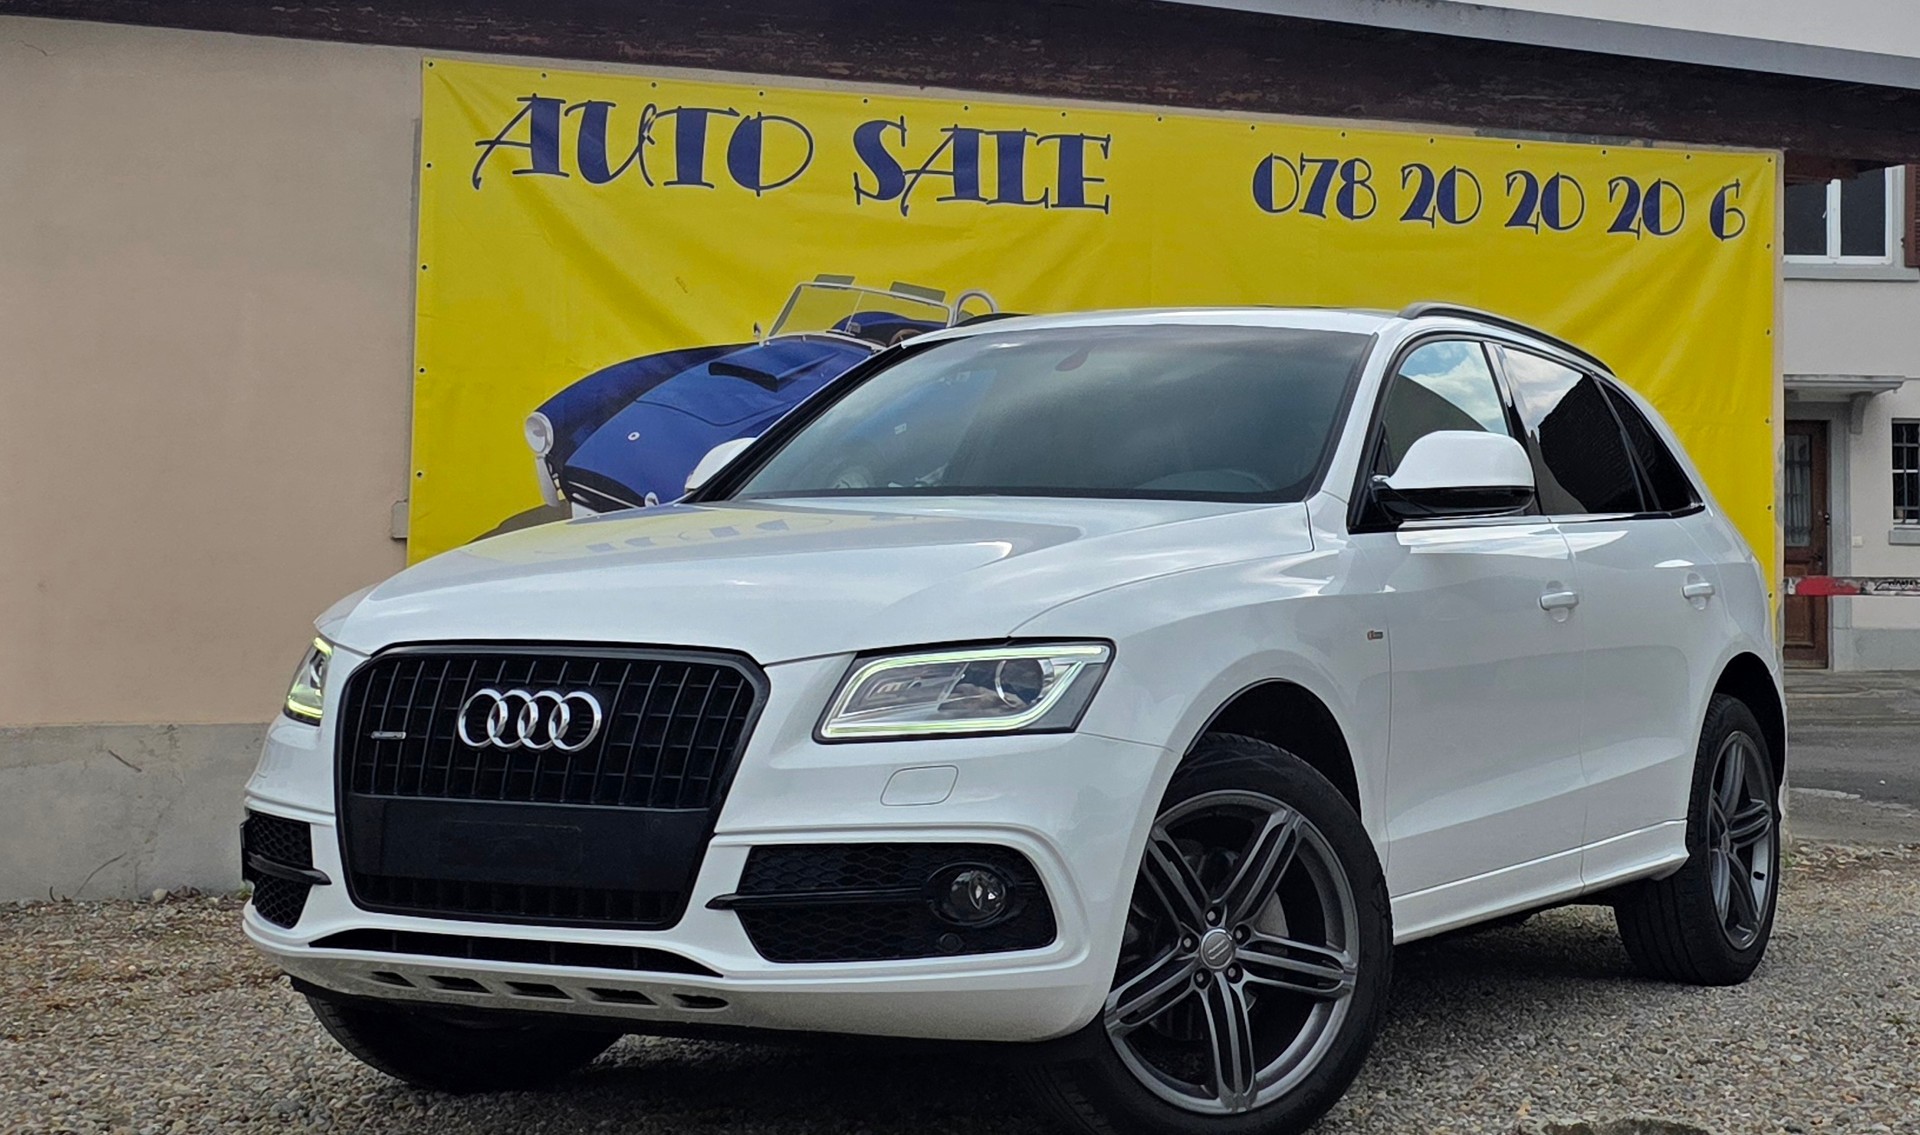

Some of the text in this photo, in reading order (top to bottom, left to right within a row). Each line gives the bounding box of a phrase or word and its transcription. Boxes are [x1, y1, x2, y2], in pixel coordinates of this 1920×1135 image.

[473, 92, 1111, 217] AUTO SALE
[1252, 152, 1745, 241] 078 20 20 20 6
